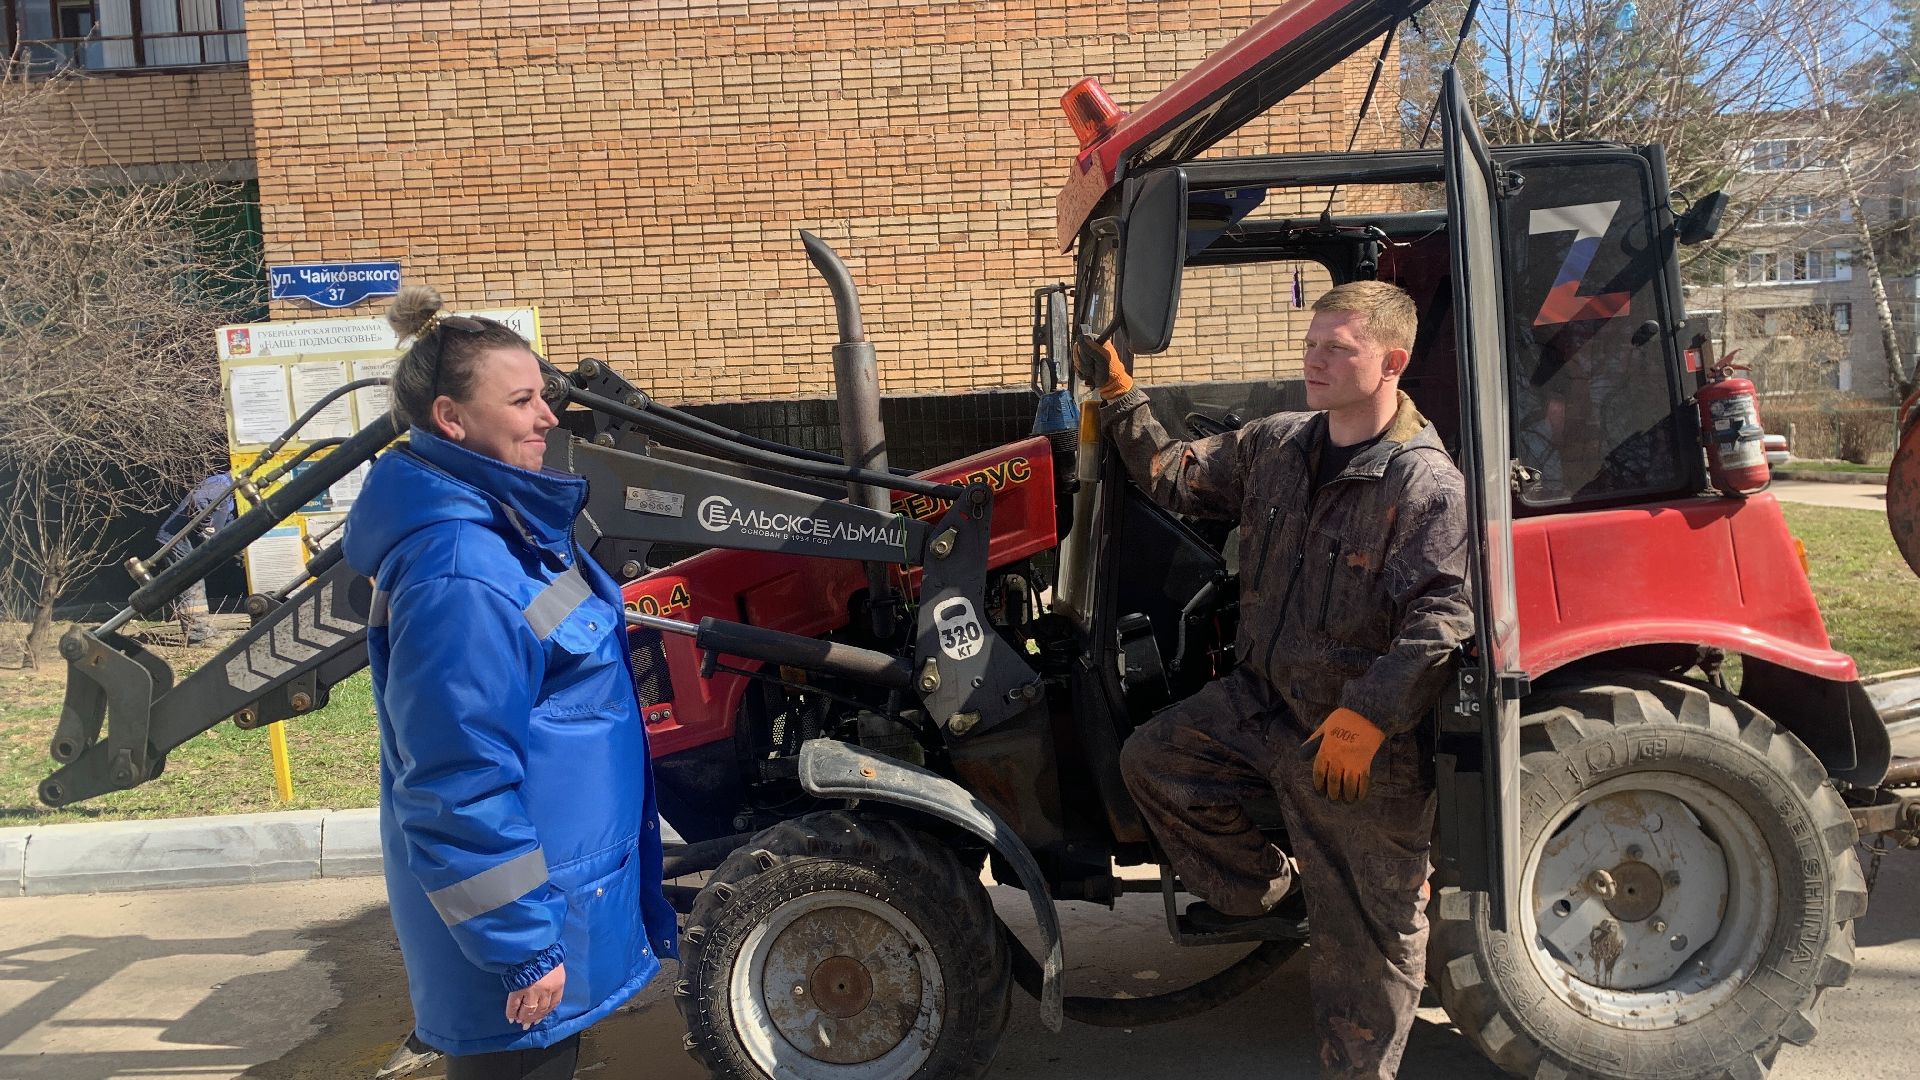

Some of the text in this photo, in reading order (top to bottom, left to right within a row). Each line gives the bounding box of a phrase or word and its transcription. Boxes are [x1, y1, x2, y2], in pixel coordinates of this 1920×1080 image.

[1528, 200, 1631, 327] Z
[272, 269, 399, 288] ул. Чайковского
[328, 288, 346, 301] 37
[257, 324, 382, 338] ГУБЕРНАТОРСКАЯ ПРОГРАММА
[299, 333, 383, 347] ПОДМОСКОВЬЕ»
[741, 528, 780, 538] ОСНОВАН
[941, 621, 980, 649] 320
